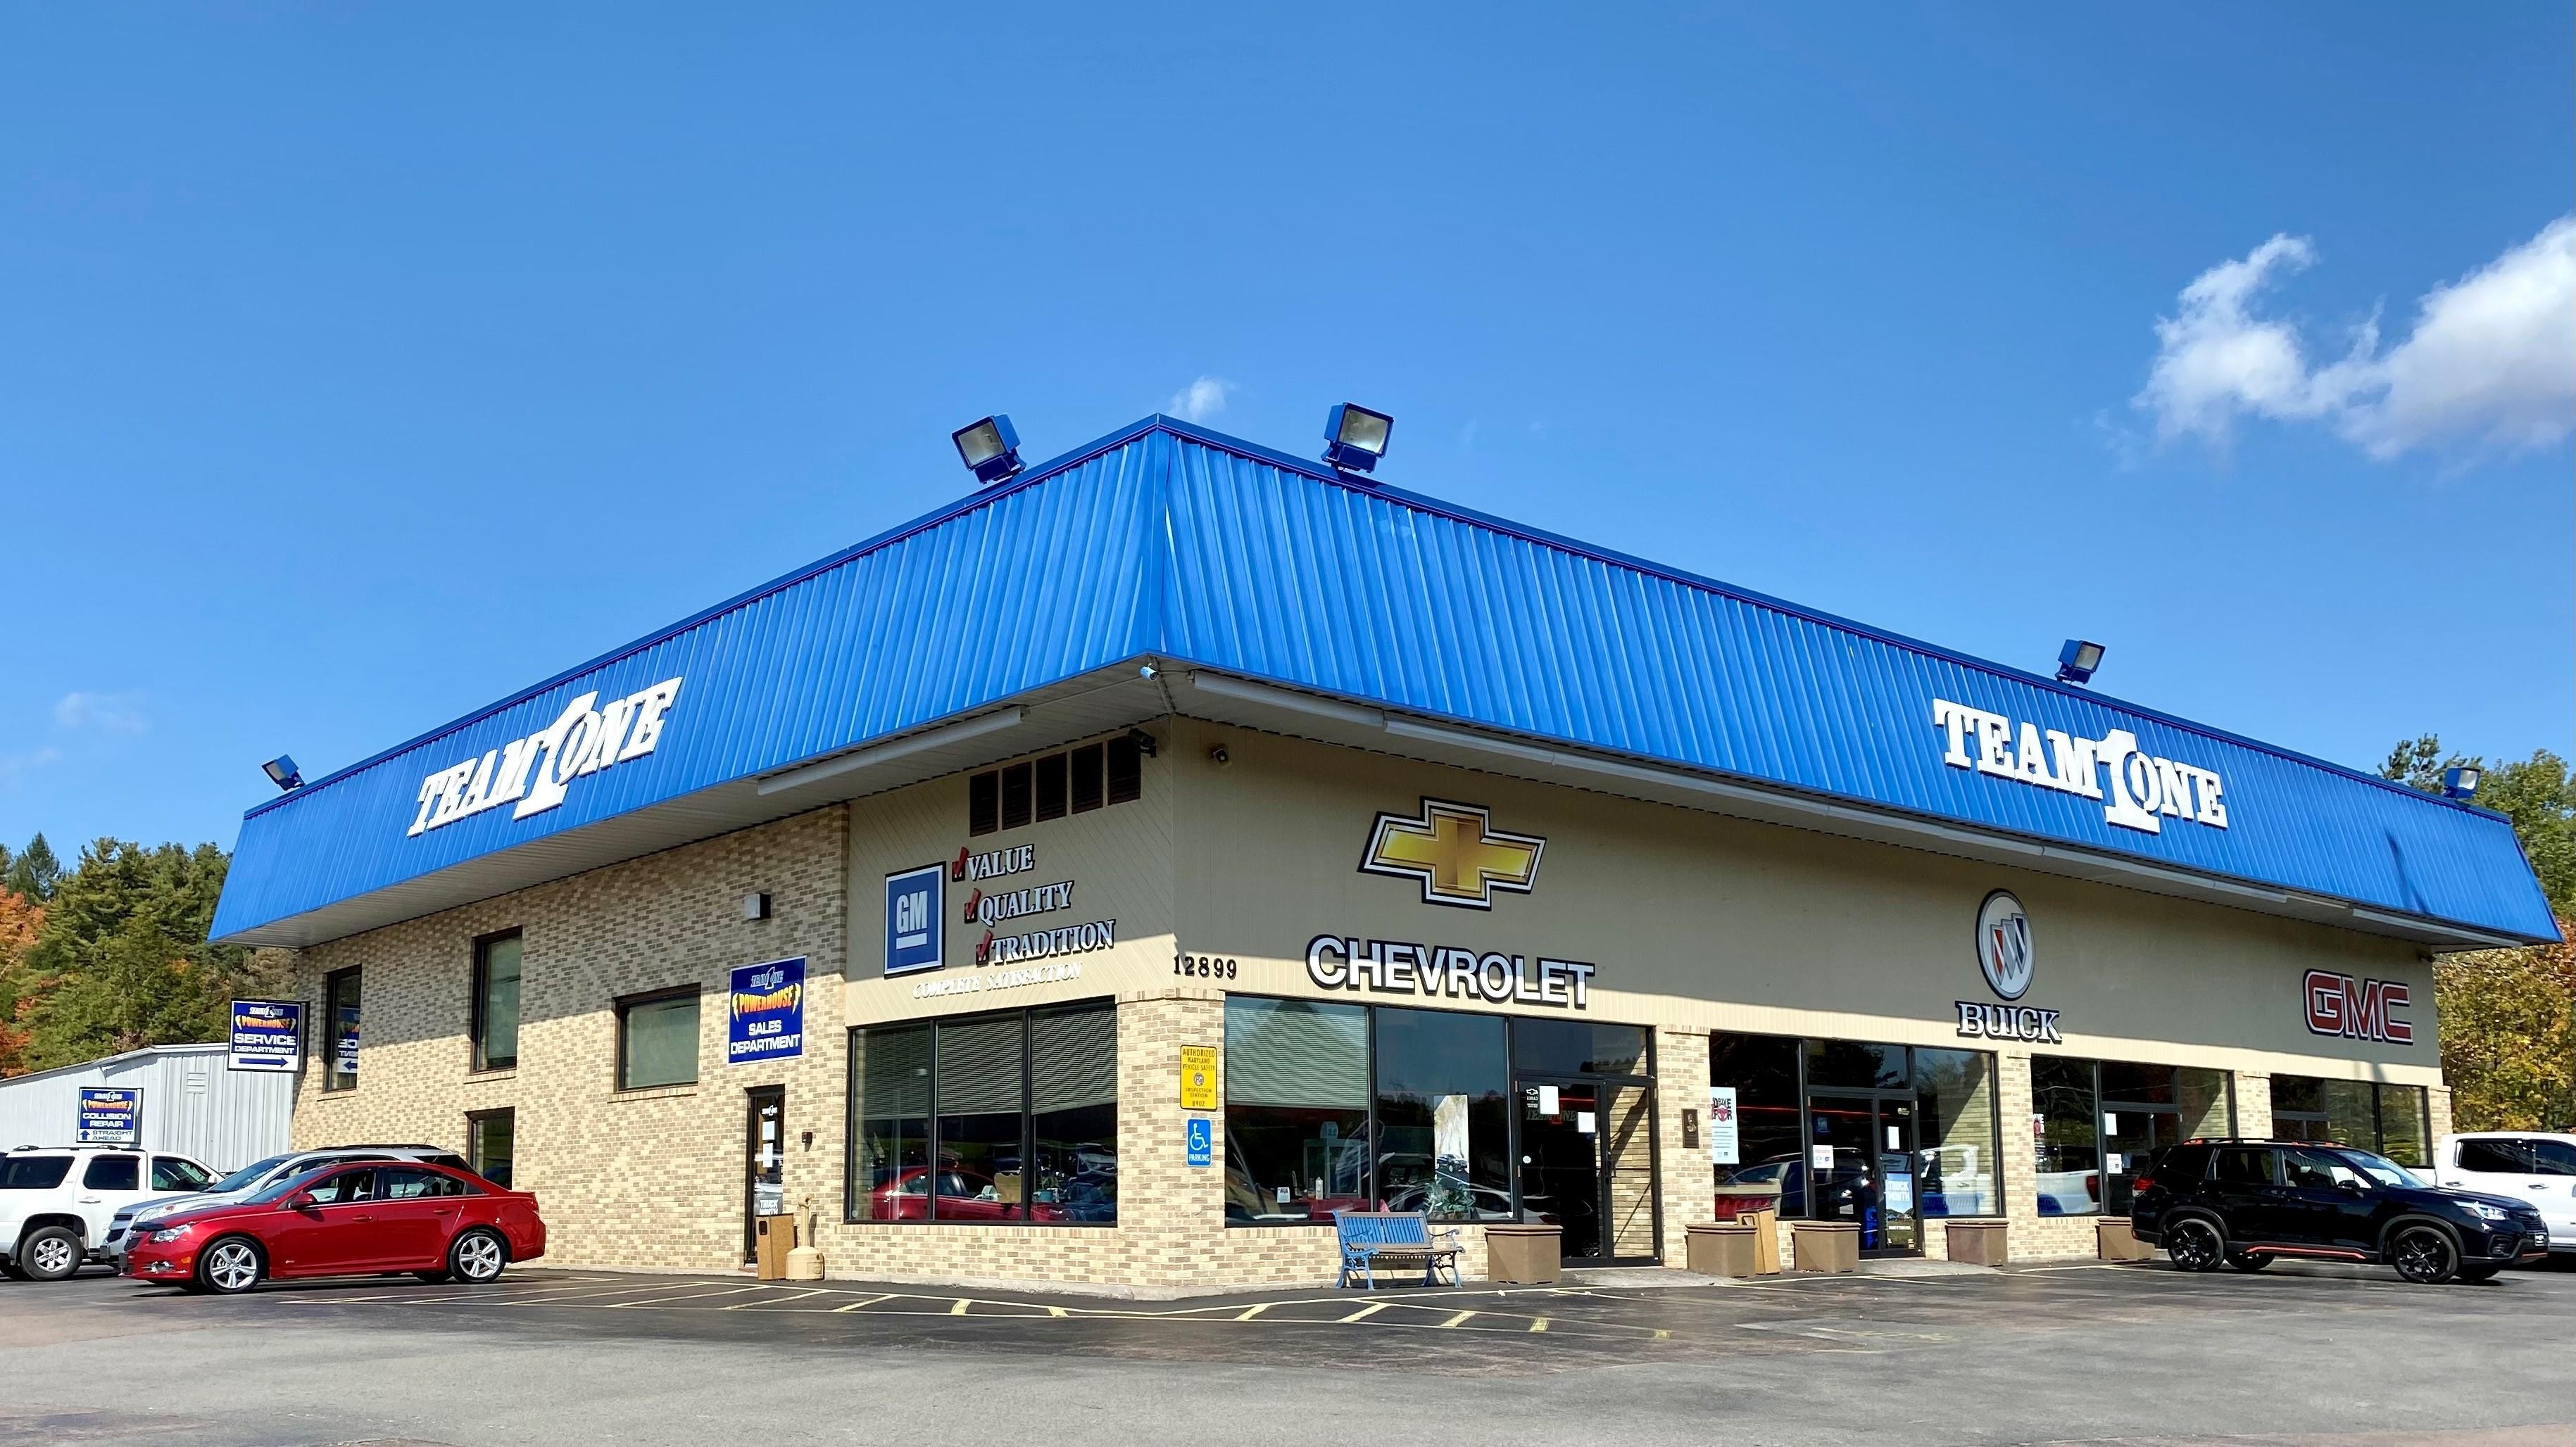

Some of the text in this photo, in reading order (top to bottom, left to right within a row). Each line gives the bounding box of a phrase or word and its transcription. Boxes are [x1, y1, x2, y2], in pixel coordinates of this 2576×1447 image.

[967, 844, 1034, 881] VALUE
[896, 890, 929, 935] GM
[978, 880, 1074, 927] QUALITY
[991, 919, 1116, 966] TRADITION
[913, 962, 1082, 999] COMPLETE SATISFACTION
[1173, 956, 1238, 980] 12899
[1306, 934, 1595, 1009] CHEVROLET
[739, 985, 794, 1014] POWERHOUSE
[2303, 968, 2413, 1046] GMC
[241, 1015, 291, 1029] POWERHOUSE
[748, 1020, 781, 1036] SALES
[1955, 1000, 2063, 1044] BUICK
[234, 1033, 296, 1046] SERVICE
[234, 1045, 294, 1054] DEPARTMENT
[730, 1034, 800, 1055] DEPARTMENT
[1183, 1048, 1215, 1058] AUTHORIZED
[1188, 1154, 1210, 1163] PARKING
